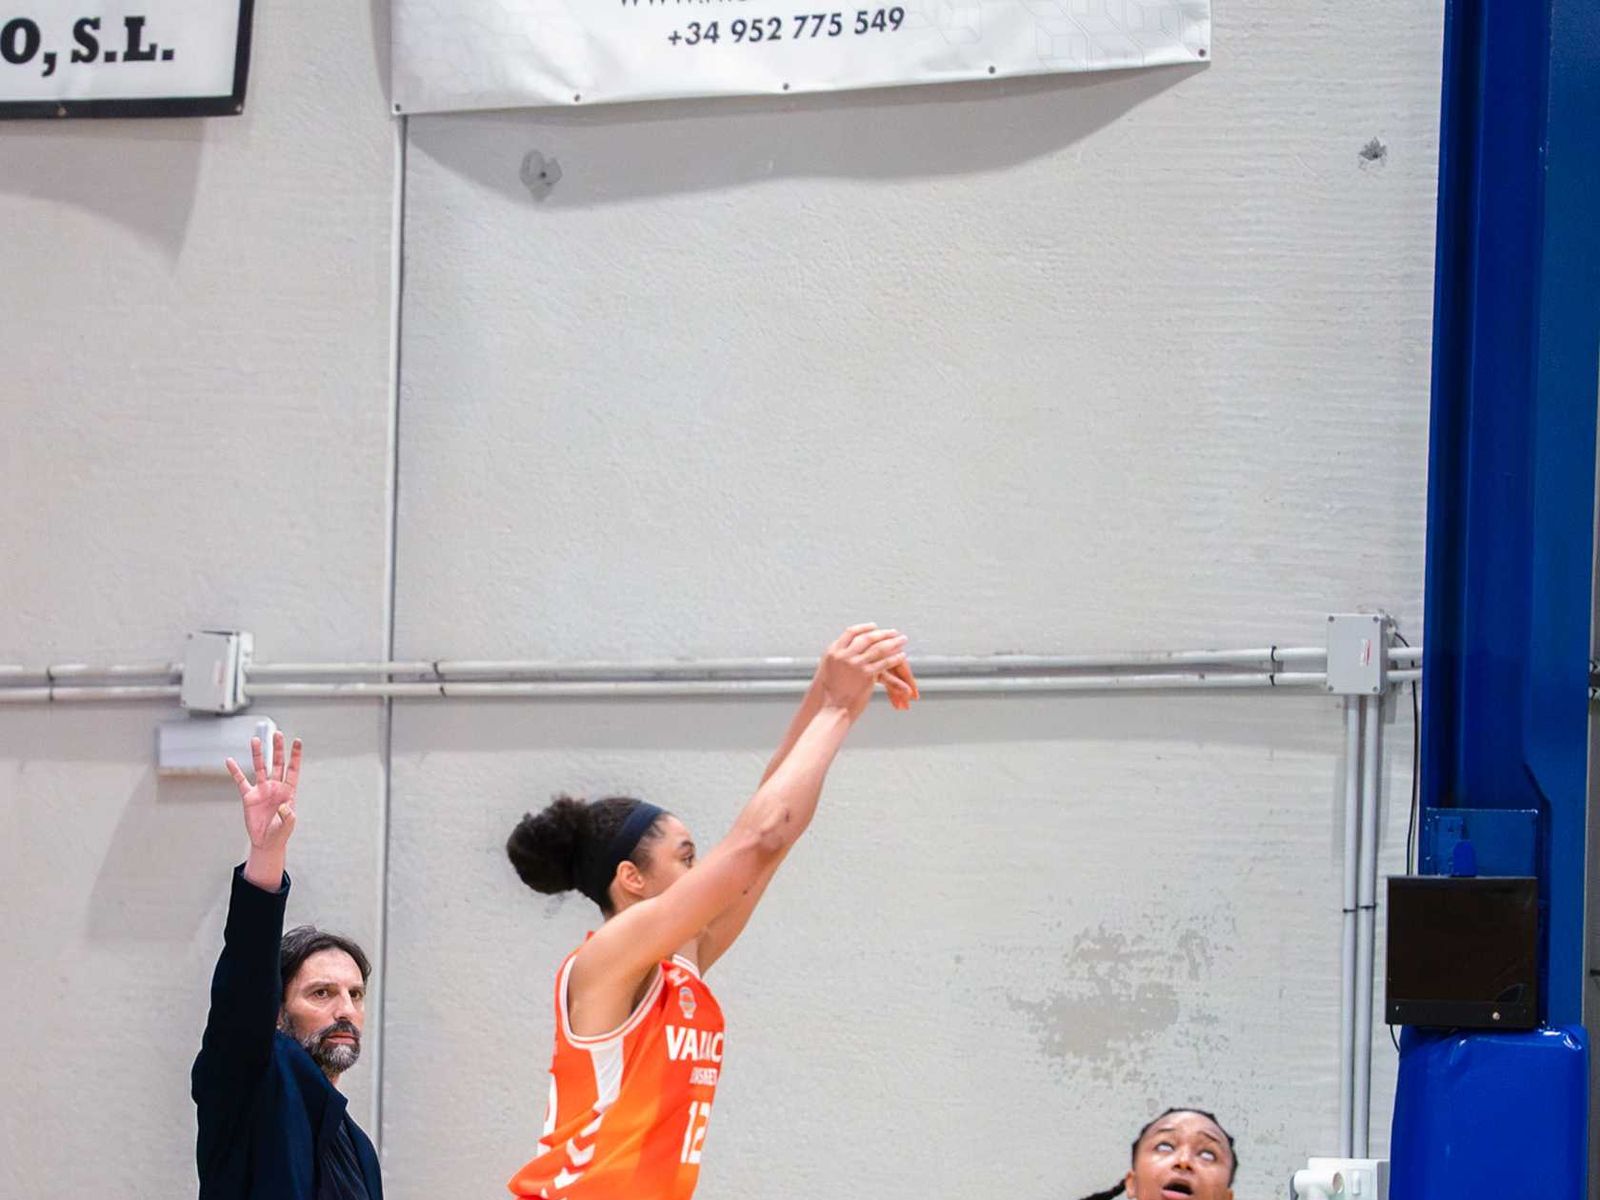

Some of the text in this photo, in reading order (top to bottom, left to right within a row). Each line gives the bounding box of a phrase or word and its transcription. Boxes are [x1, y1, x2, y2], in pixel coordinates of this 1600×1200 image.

[0, 16, 174, 77] O, S.L.
[668, 7, 905, 46] +34 952 775 549
